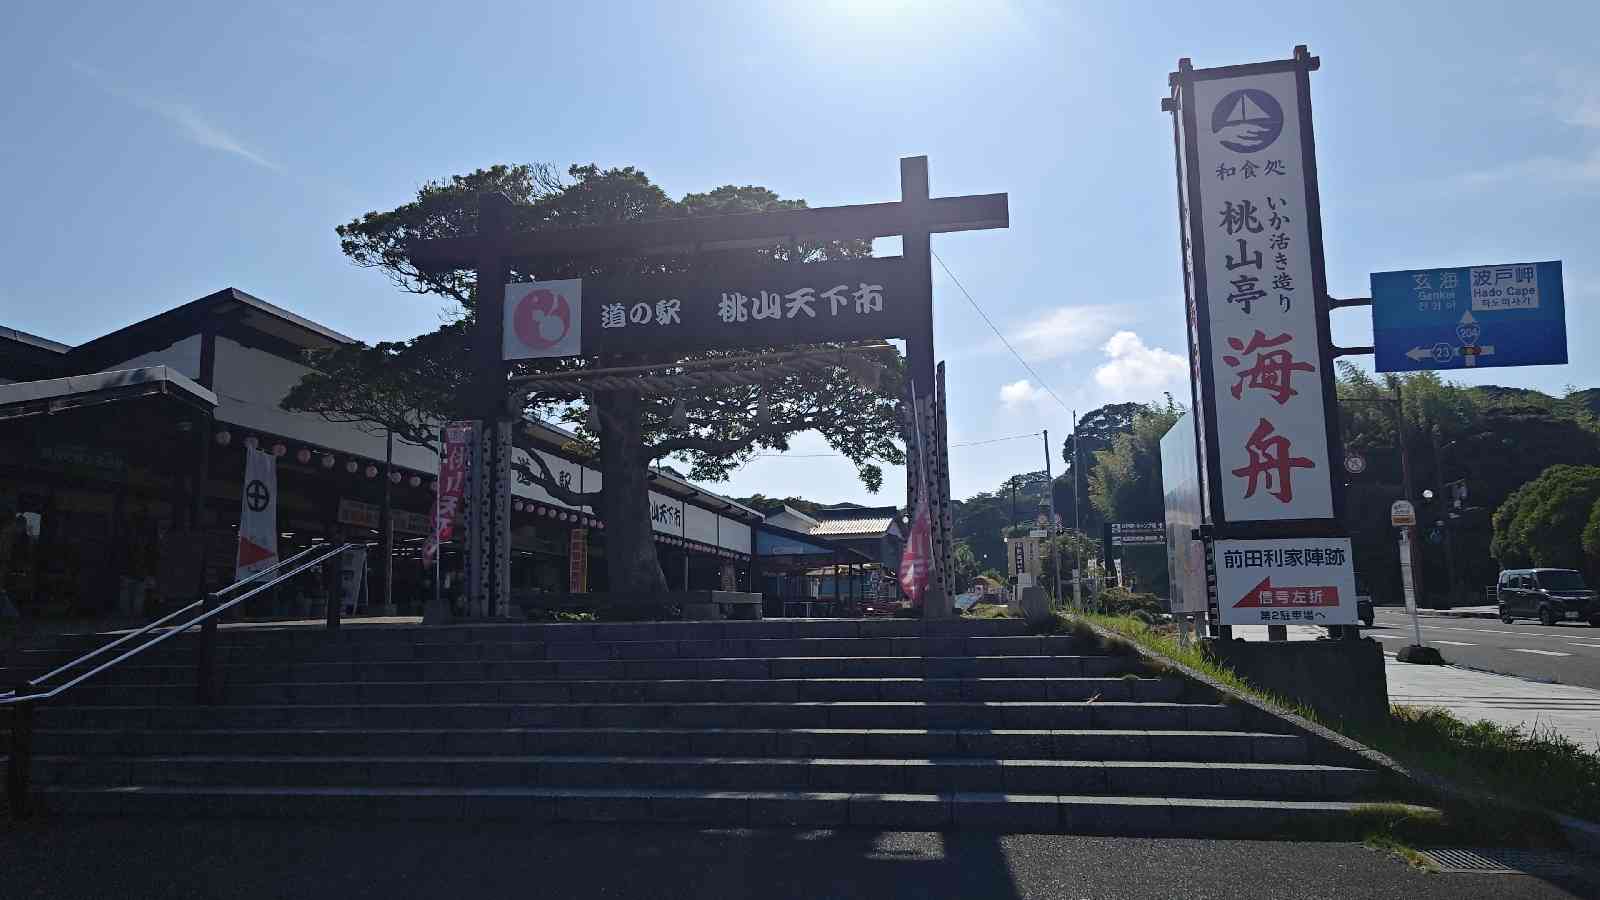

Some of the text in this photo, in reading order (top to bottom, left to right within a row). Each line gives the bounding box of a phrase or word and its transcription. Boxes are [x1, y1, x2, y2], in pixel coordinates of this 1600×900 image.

[1216, 159, 1287, 182] 和食処
[1219, 199, 1268, 315] 桃山亭
[1266, 196, 1296, 313] いか活き造り
[1413, 271, 1457, 290] 玄海
[1473, 266, 1534, 287] 波戸岬
[1474, 285, 1536, 298] Hado Cape
[601, 282, 884, 329] 道の駅 桃山天下市
[1461, 327, 1479, 338] 204
[1436, 347, 1450, 358] 23
[1222, 329, 1316, 504] 海舟
[651, 500, 681, 529] 山天下市
[1224, 549, 1346, 569] 前田利家陣跡
[1259, 589, 1323, 605] 信号左折
[1260, 610, 1326, 621] 第2駐車場へ
